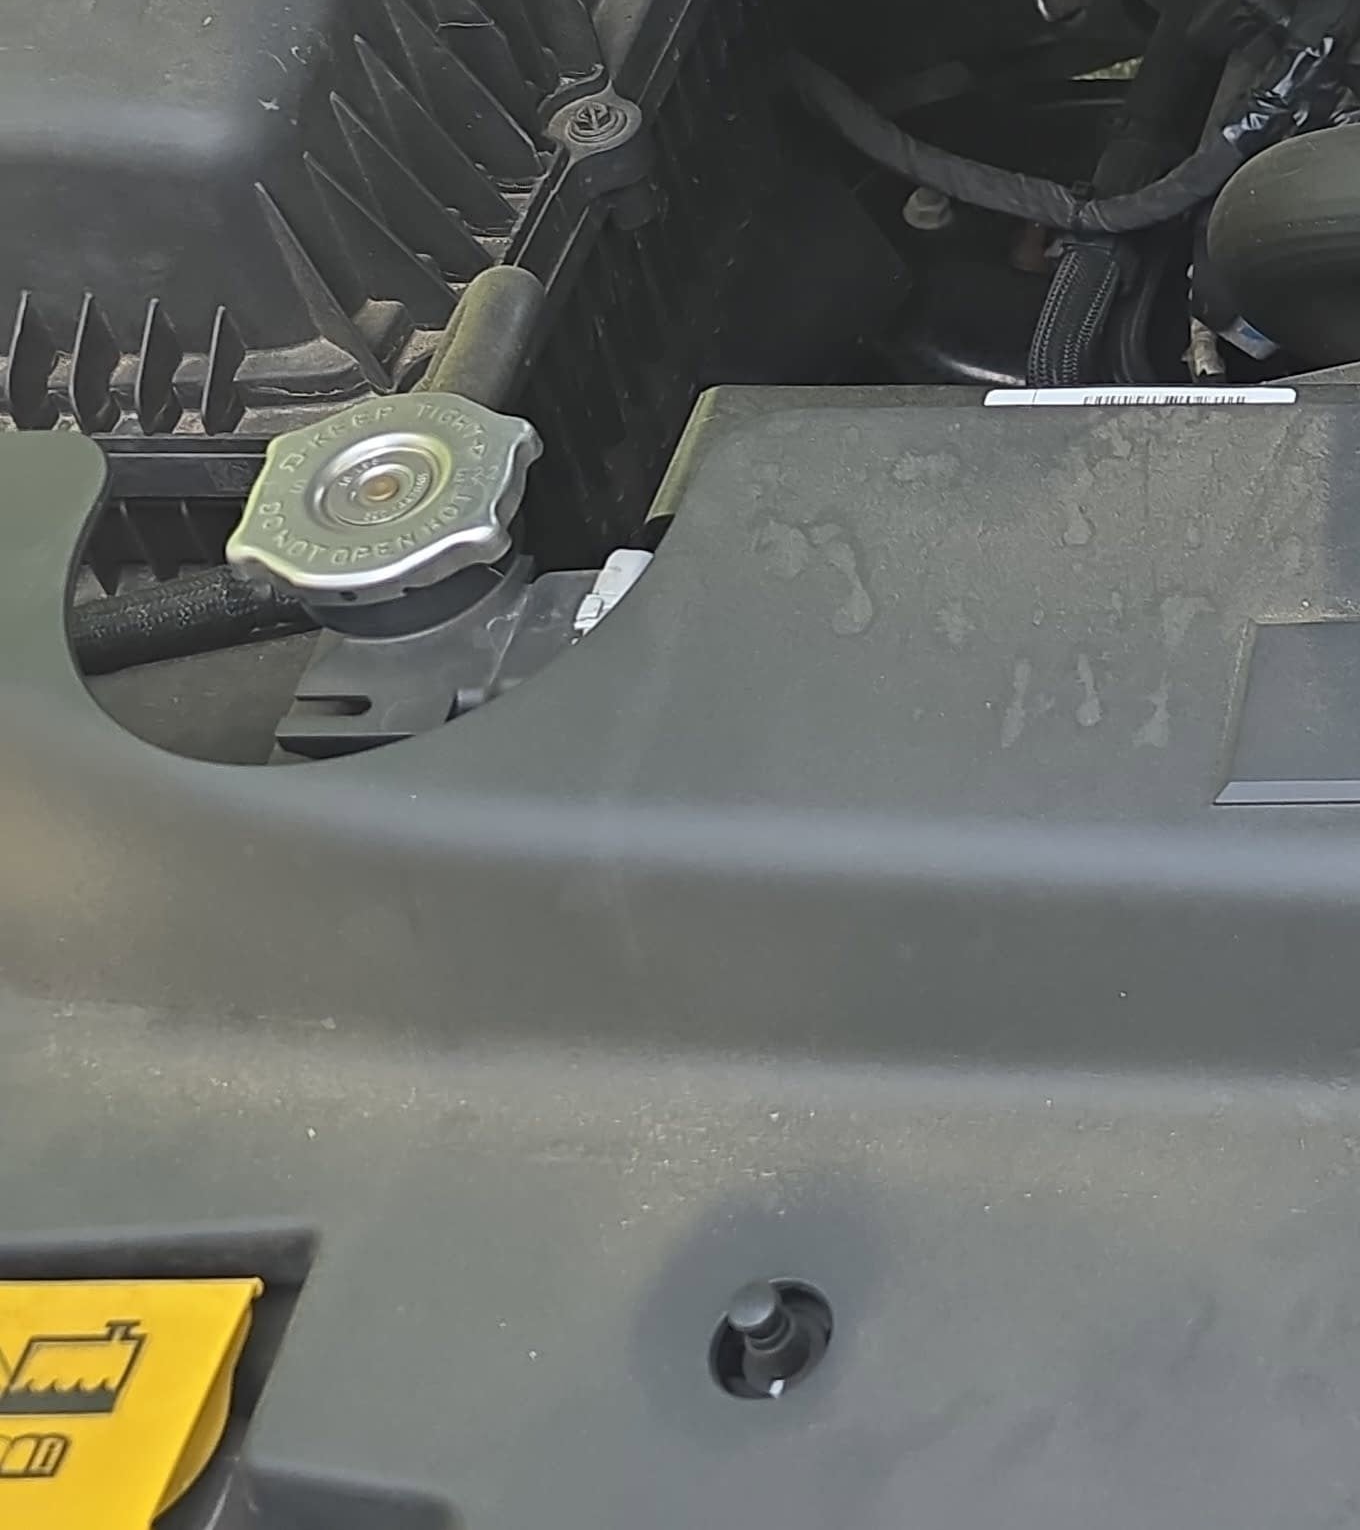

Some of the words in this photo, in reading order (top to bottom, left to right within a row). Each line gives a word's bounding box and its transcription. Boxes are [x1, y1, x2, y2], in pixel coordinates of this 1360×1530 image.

[309, 406, 395, 448] KEEP
[416, 404, 486, 438] TIGHT
[274, 528, 329, 563] NOT
[330, 532, 419, 565] OPEN
[421, 494, 472, 535] HOT
